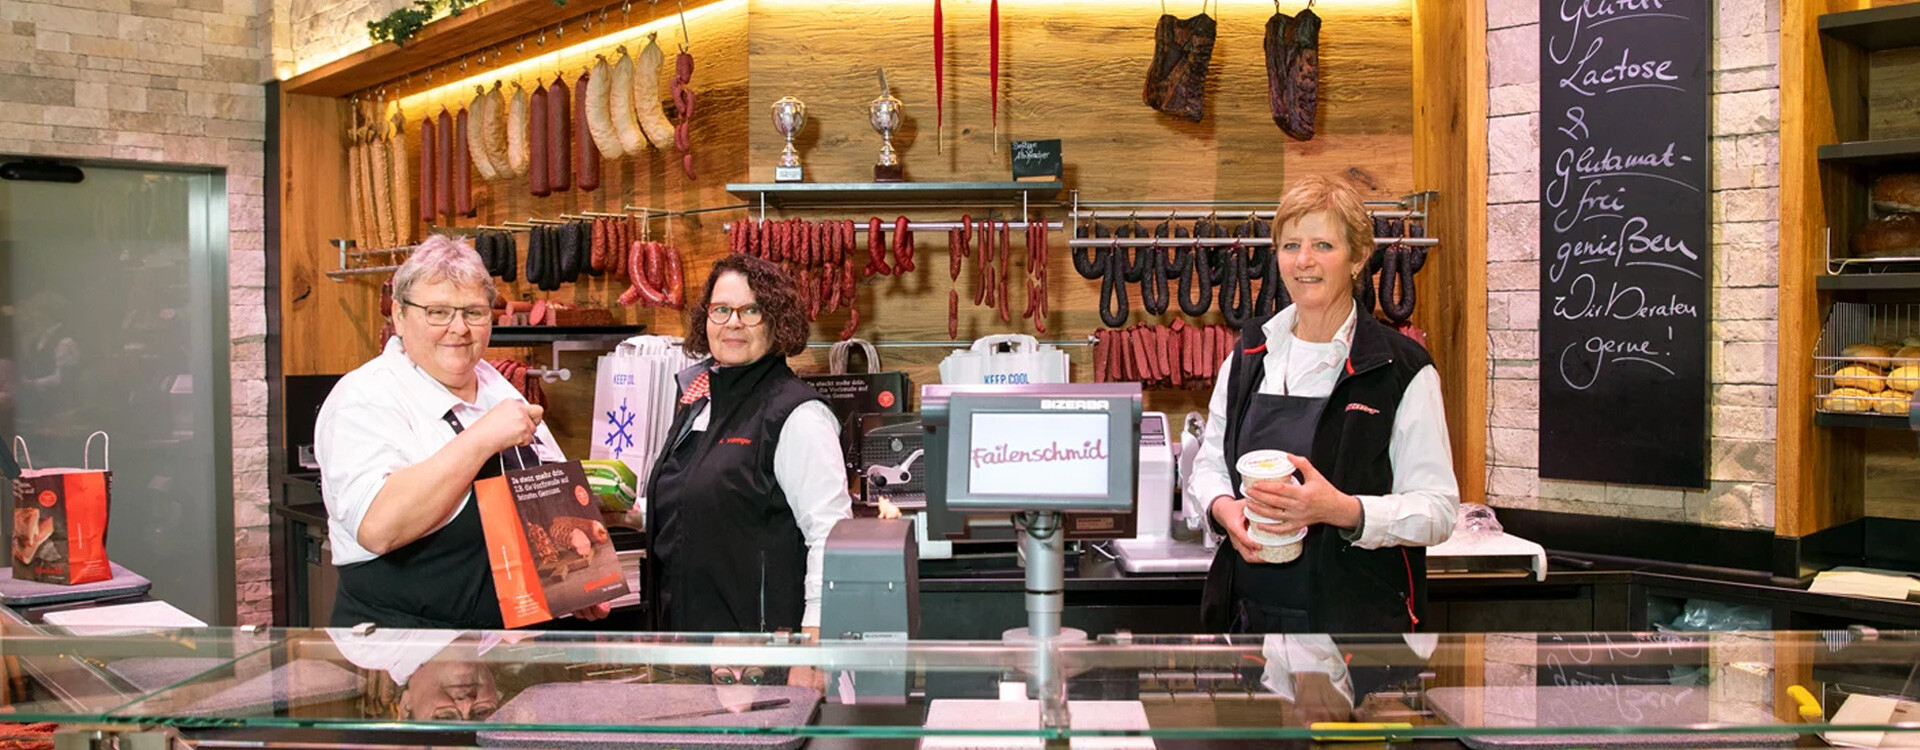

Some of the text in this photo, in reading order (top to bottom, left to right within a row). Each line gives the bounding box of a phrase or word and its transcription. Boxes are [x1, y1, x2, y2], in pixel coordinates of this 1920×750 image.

[1560, 36, 1679, 96] Lactose
[1558, 106, 1590, 141] &
[1546, 142, 1692, 209] Glutamat-
[1554, 179, 1626, 233] frei
[1549, 217, 1698, 283] genießen
[1553, 274, 1603, 320] Wir
[972, 438, 1107, 468] Failenschmid
